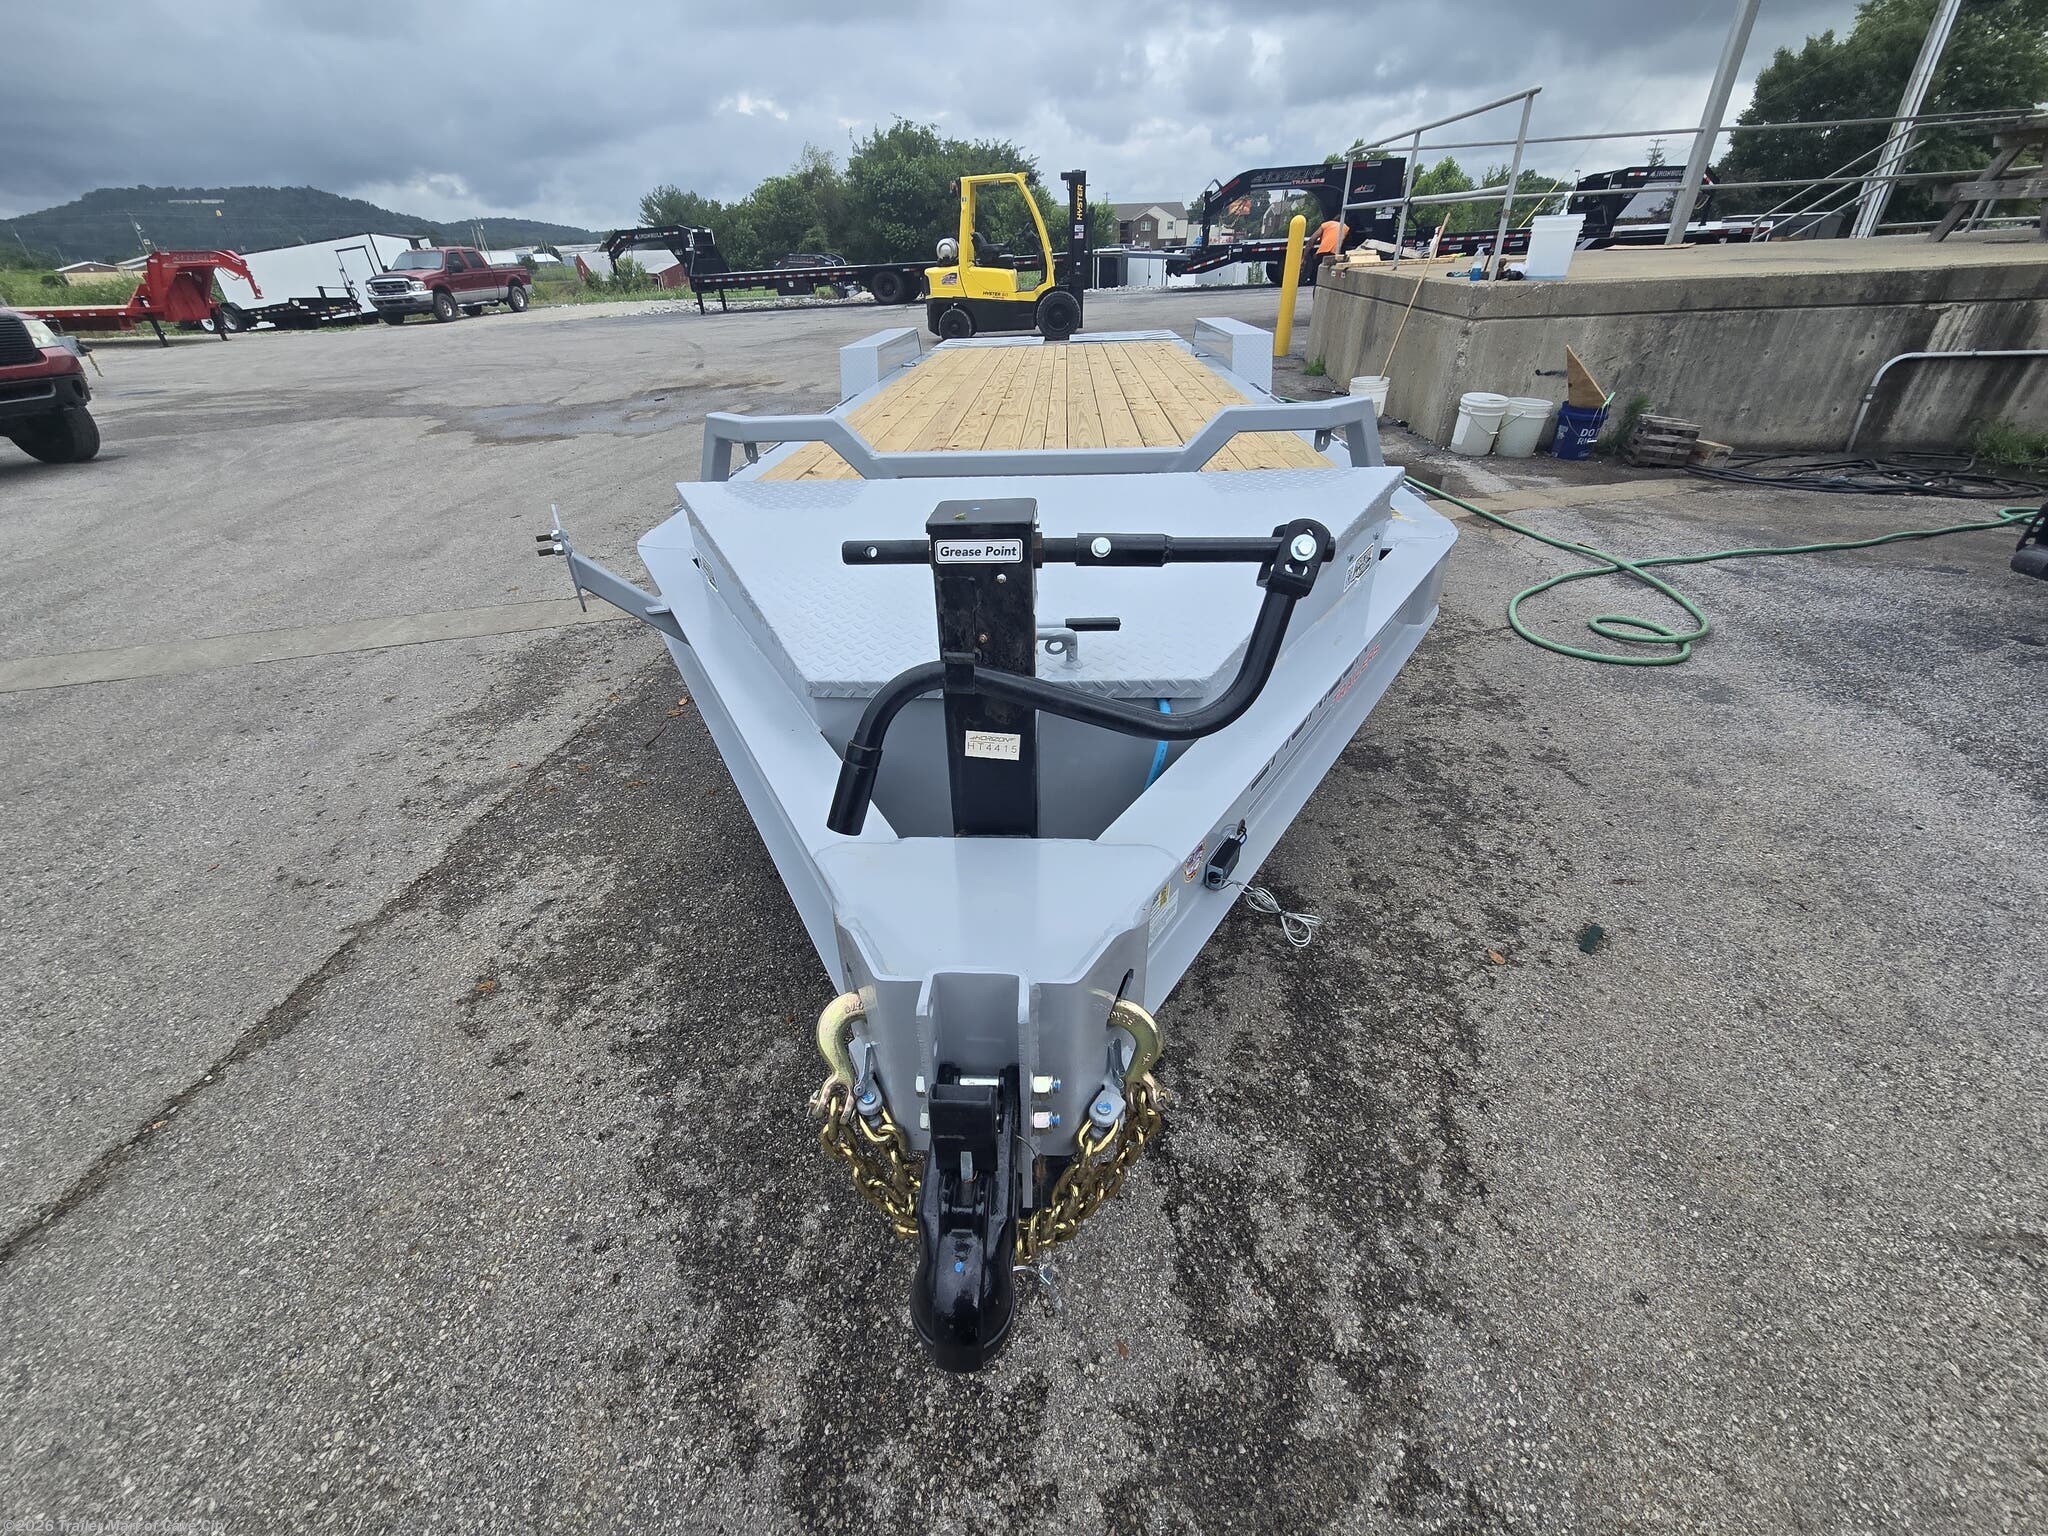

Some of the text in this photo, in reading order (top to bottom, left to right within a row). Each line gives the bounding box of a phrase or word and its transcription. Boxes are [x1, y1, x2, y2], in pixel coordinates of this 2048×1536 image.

[1291, 177, 1325, 185] TRAILERS
[940, 545, 1017, 557] Grease Point
[967, 741, 1017, 754] HT4415
